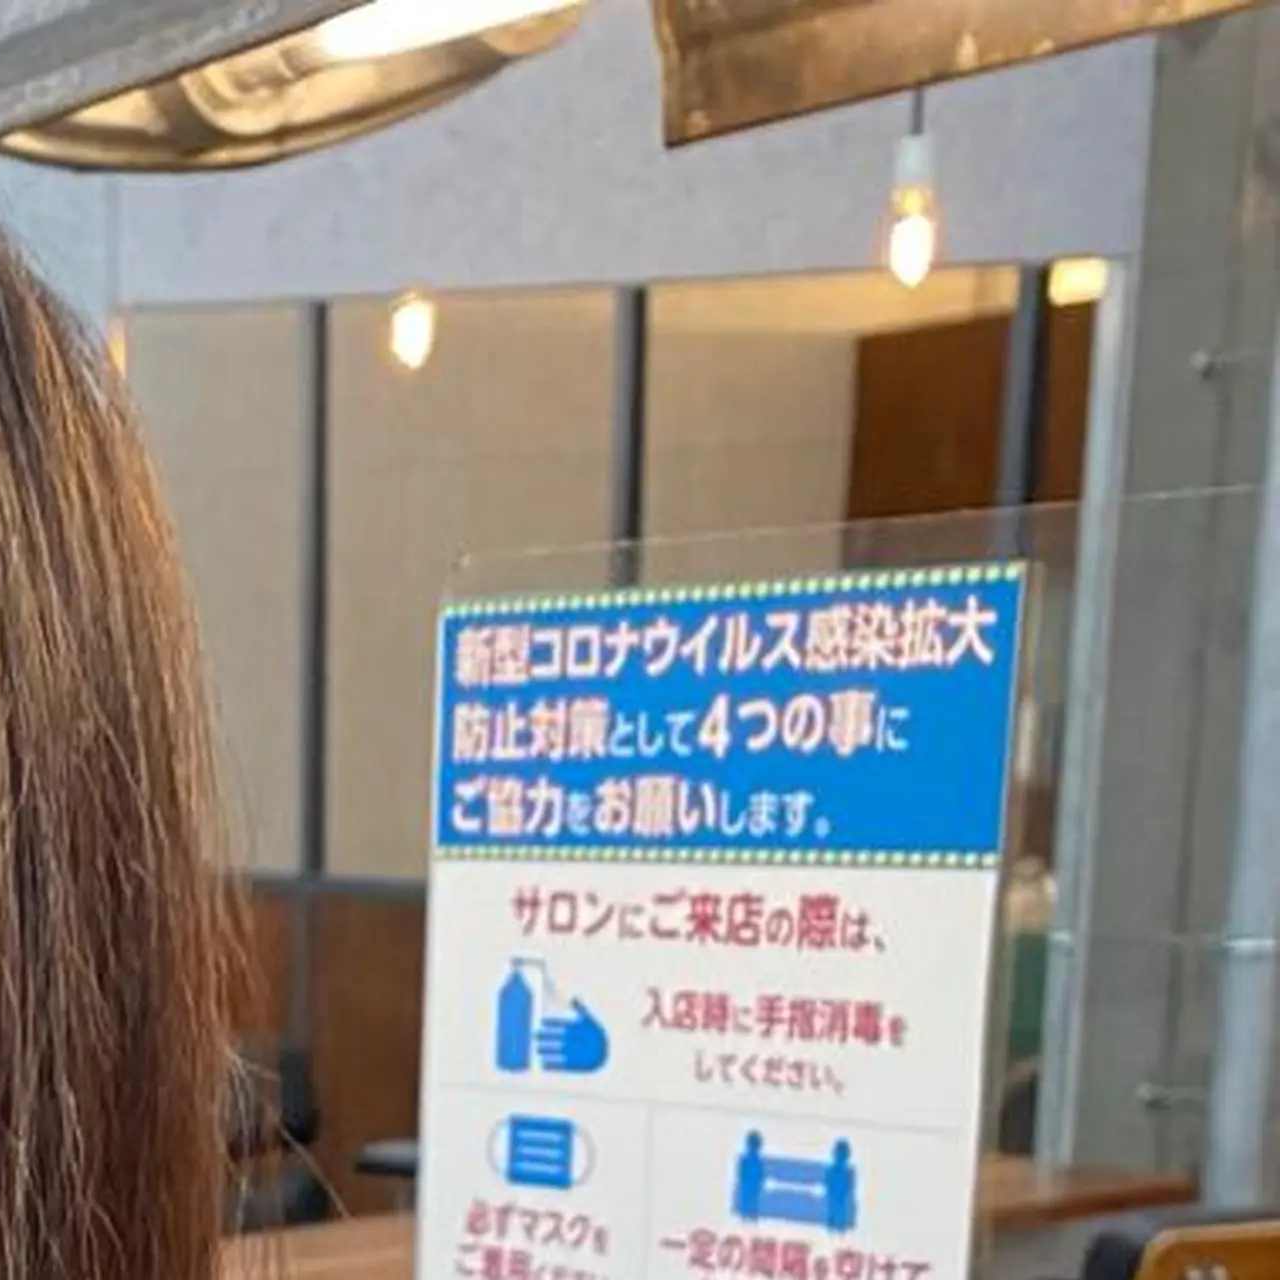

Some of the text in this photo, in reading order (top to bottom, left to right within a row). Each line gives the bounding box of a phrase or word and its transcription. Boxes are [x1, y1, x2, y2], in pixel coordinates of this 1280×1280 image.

[455, 595, 998, 687] 新型コロナウイルス感染拡大
[451, 775, 831, 838] ご協力をお願いします。
[511, 886, 887, 953] サロンにご来店の際は、
[695, 1049, 845, 1093] してください。
